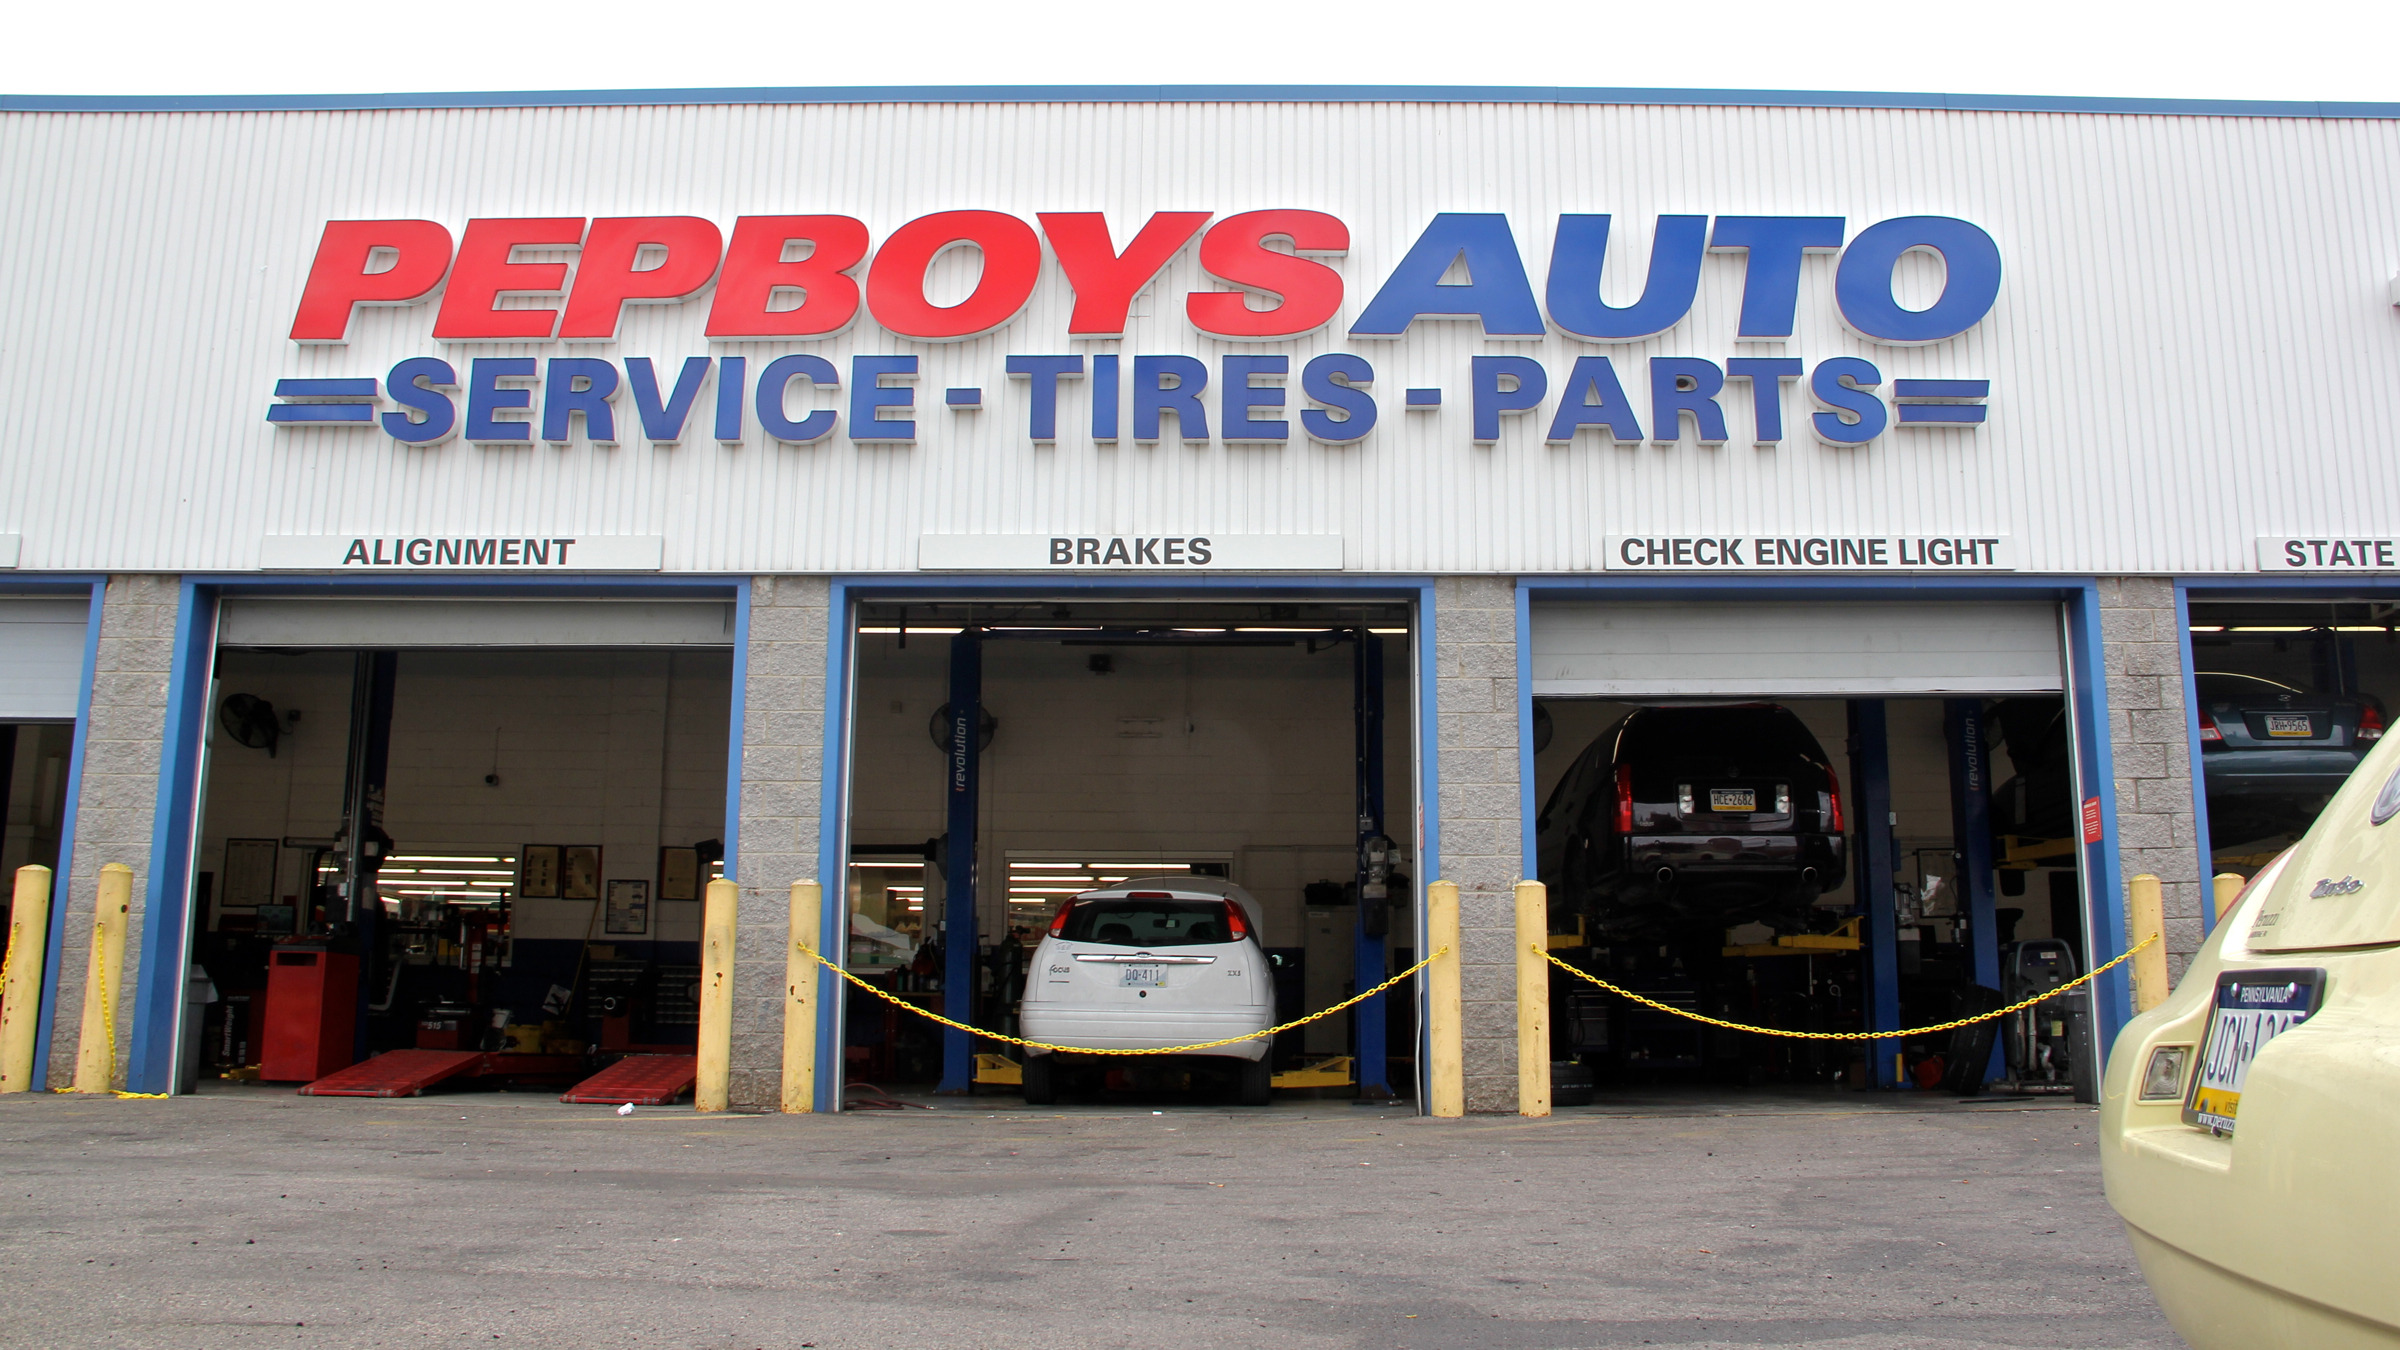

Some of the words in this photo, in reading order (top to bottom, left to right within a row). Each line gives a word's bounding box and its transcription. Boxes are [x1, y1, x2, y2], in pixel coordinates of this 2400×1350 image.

[1349, 211, 2003, 342] AUTO
[381, 353, 919, 445] SERVICE
[1006, 352, 1378, 442] TIRES
[1473, 355, 1888, 443] PARTS
[342, 538, 576, 566] ALIGNMENT
[1049, 537, 1212, 566] BRAKES
[1620, 538, 1744, 566] CHECK
[1754, 538, 1888, 566] ENGINE
[1898, 538, 1999, 565] LIGHT
[2284, 540, 2395, 567] STATE
[954, 717, 967, 788] revolution
[2240, 986, 2288, 1003] PENNSYLVANIA
